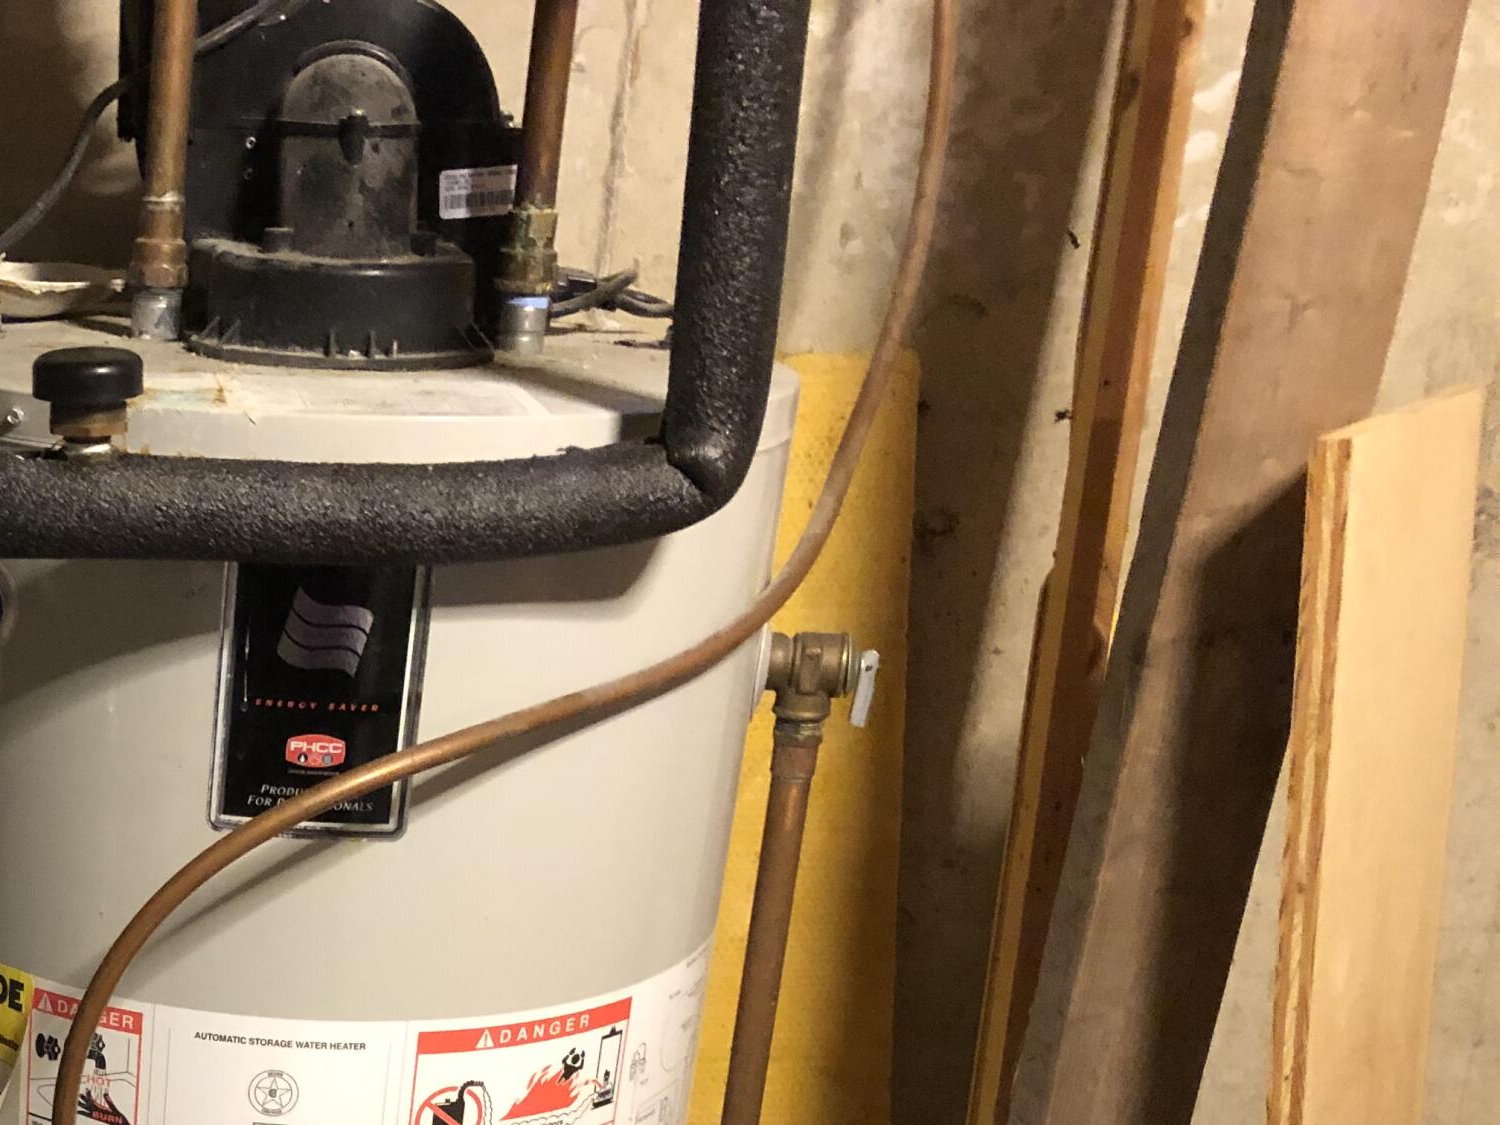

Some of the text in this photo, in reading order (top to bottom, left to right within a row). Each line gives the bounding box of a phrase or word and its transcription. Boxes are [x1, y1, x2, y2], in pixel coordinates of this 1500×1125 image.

[290, 741, 343, 754] PHCC
[247, 795, 272, 806] FOR
[500, 1014, 590, 1044] DANGER
[194, 1032, 246, 1044] AUTOMATIC
[249, 1038, 293, 1048] STORAGE
[296, 1041, 327, 1049] WATER
[92, 1111, 122, 1124] BURN
